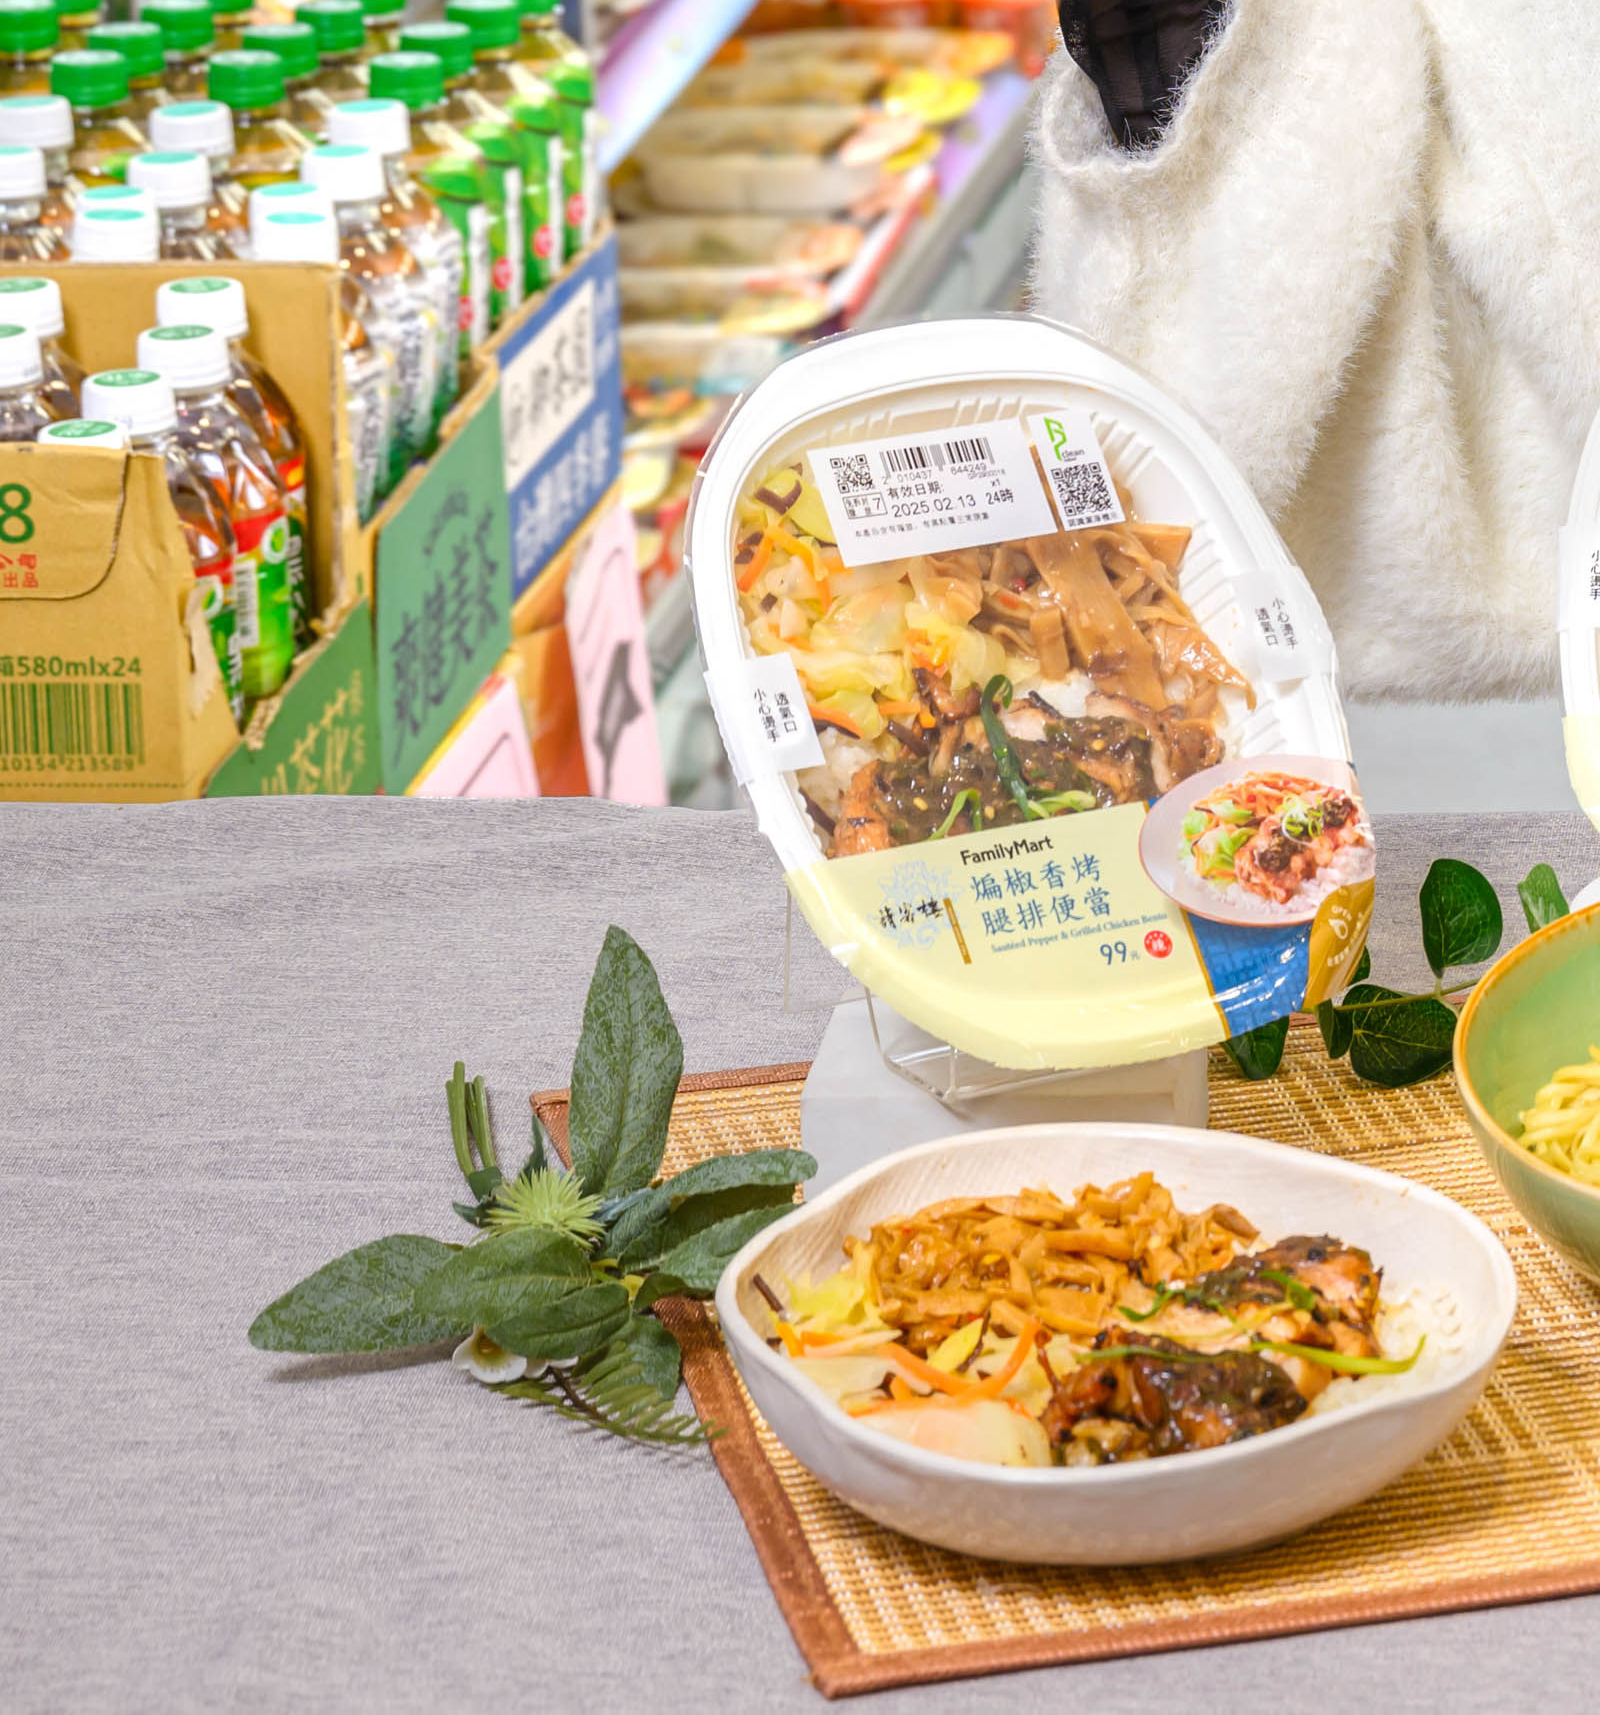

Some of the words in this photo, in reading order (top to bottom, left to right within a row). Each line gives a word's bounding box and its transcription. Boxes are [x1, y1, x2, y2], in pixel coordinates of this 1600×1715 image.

[891, 493, 977, 518] 2025.02.13
[985, 488, 1015, 506] 24時
[960, 835, 1054, 865] FamilyMart
[970, 852, 1101, 902] 煸椒香烤
[981, 886, 1112, 936] 腿排便當
[1103, 917, 1140, 931] Chicken
